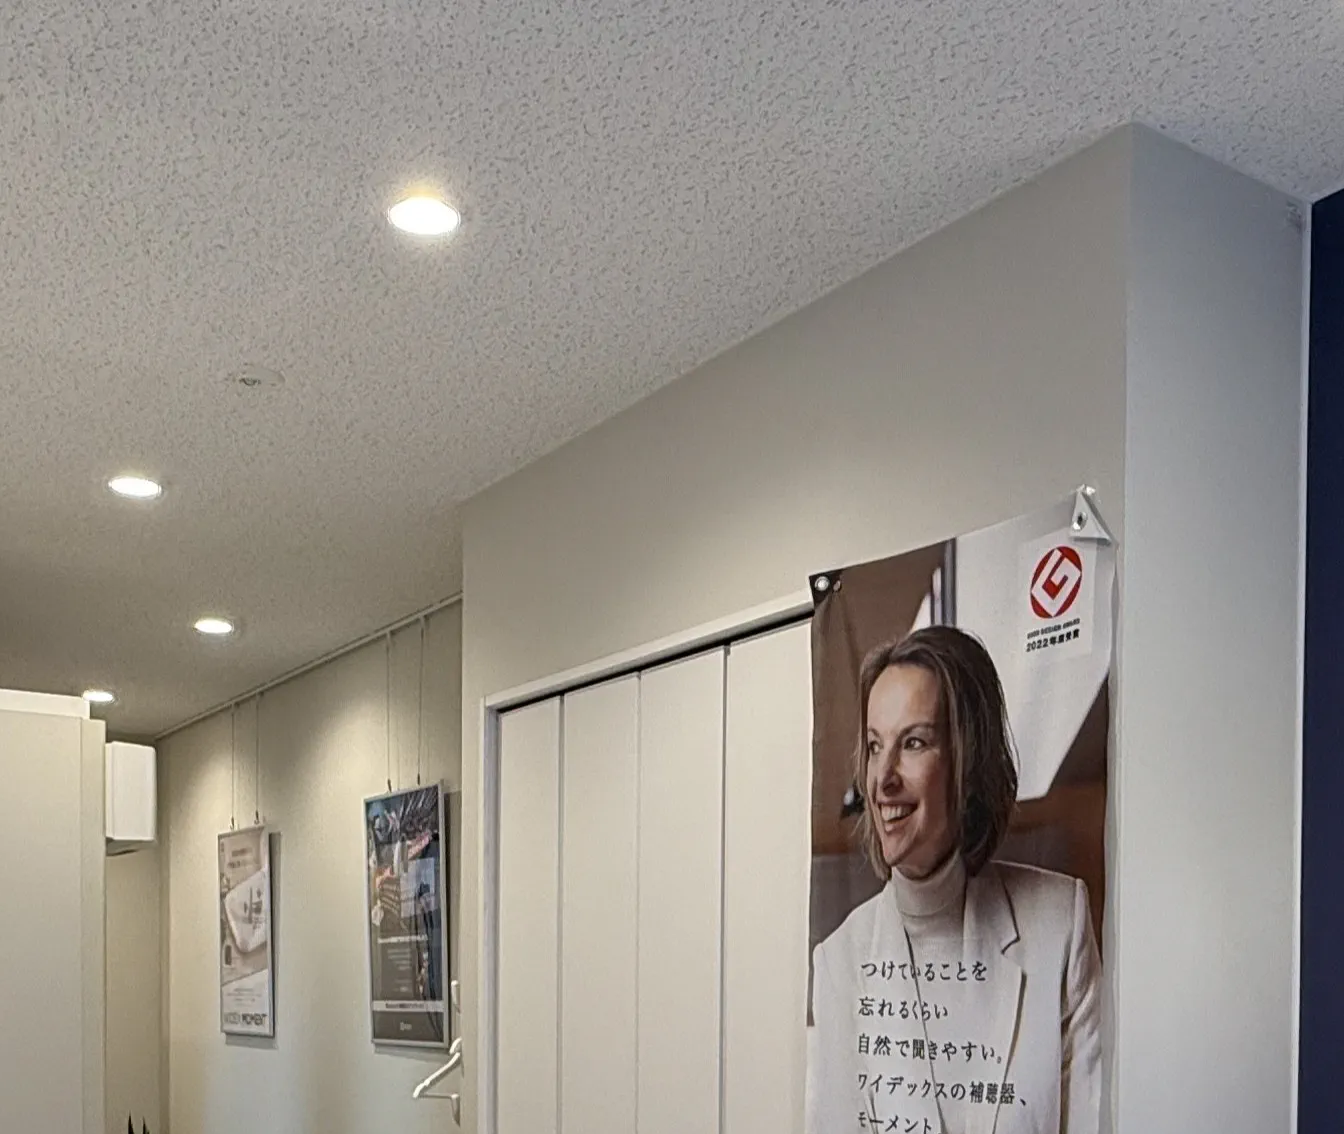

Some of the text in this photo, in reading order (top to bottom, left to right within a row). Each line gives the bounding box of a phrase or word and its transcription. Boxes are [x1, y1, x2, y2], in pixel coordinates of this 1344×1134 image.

[861, 961, 987, 982] つけていることを
[858, 996, 949, 1021] 忘れるくらい
[858, 1033, 1002, 1064] 自然で聞きやすい。
[858, 1073, 1026, 1106] ワイデックスの補聴器、
